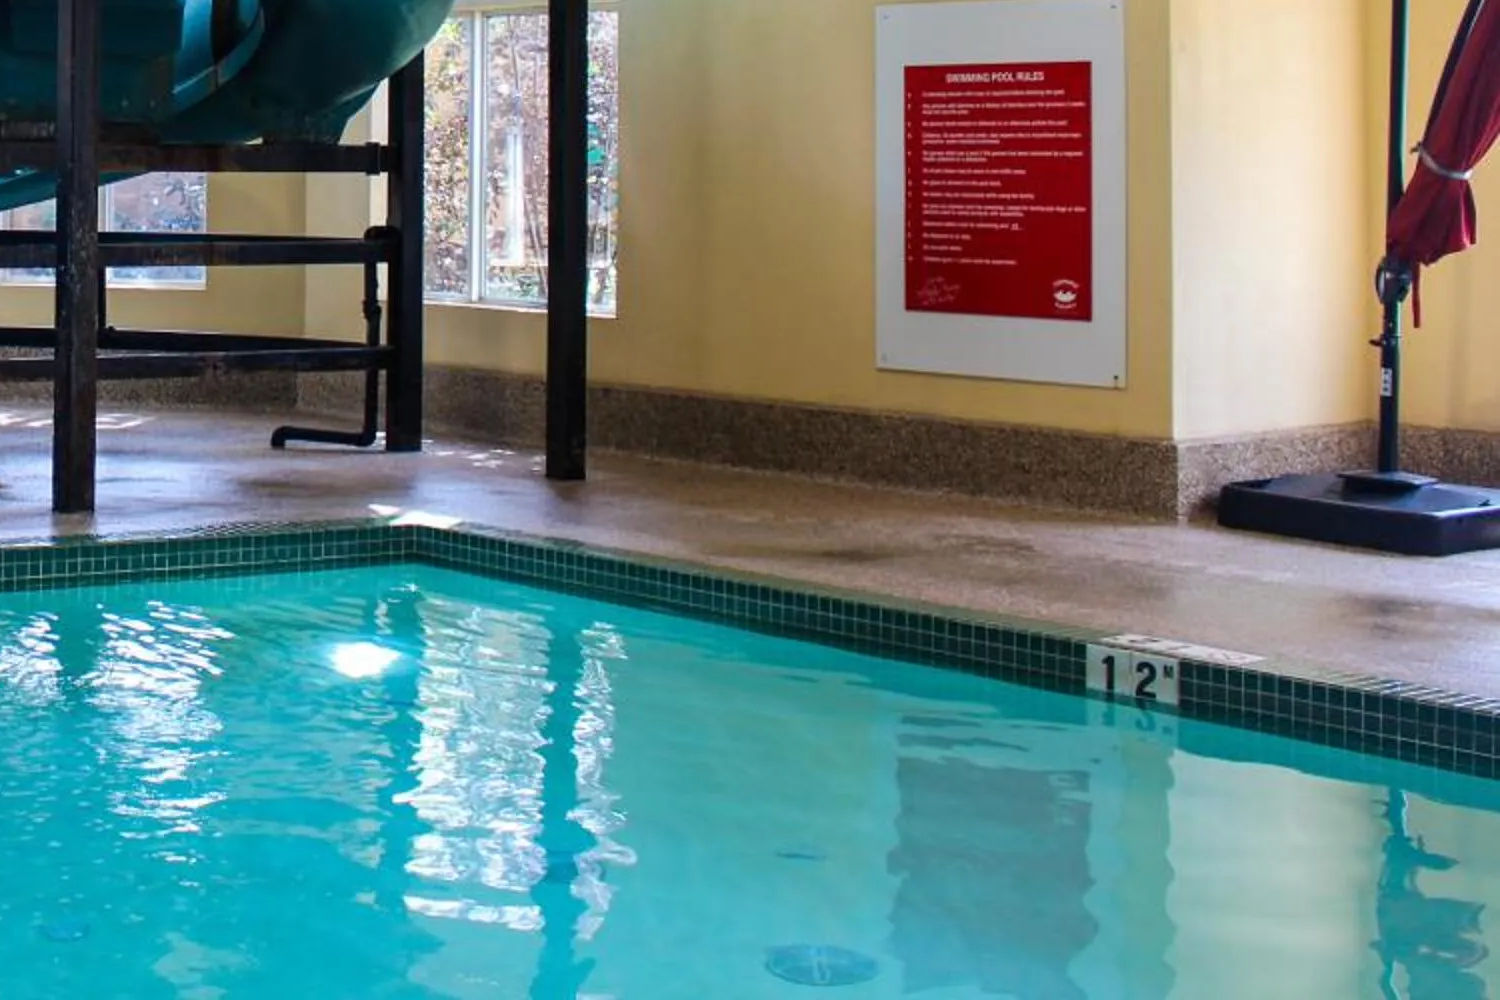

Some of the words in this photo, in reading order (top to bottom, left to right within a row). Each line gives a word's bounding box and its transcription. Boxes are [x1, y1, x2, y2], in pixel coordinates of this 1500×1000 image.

[945, 73, 990, 83] SWIMMING
[991, 71, 1014, 83] POOL
[1016, 71, 1045, 81] RULES
